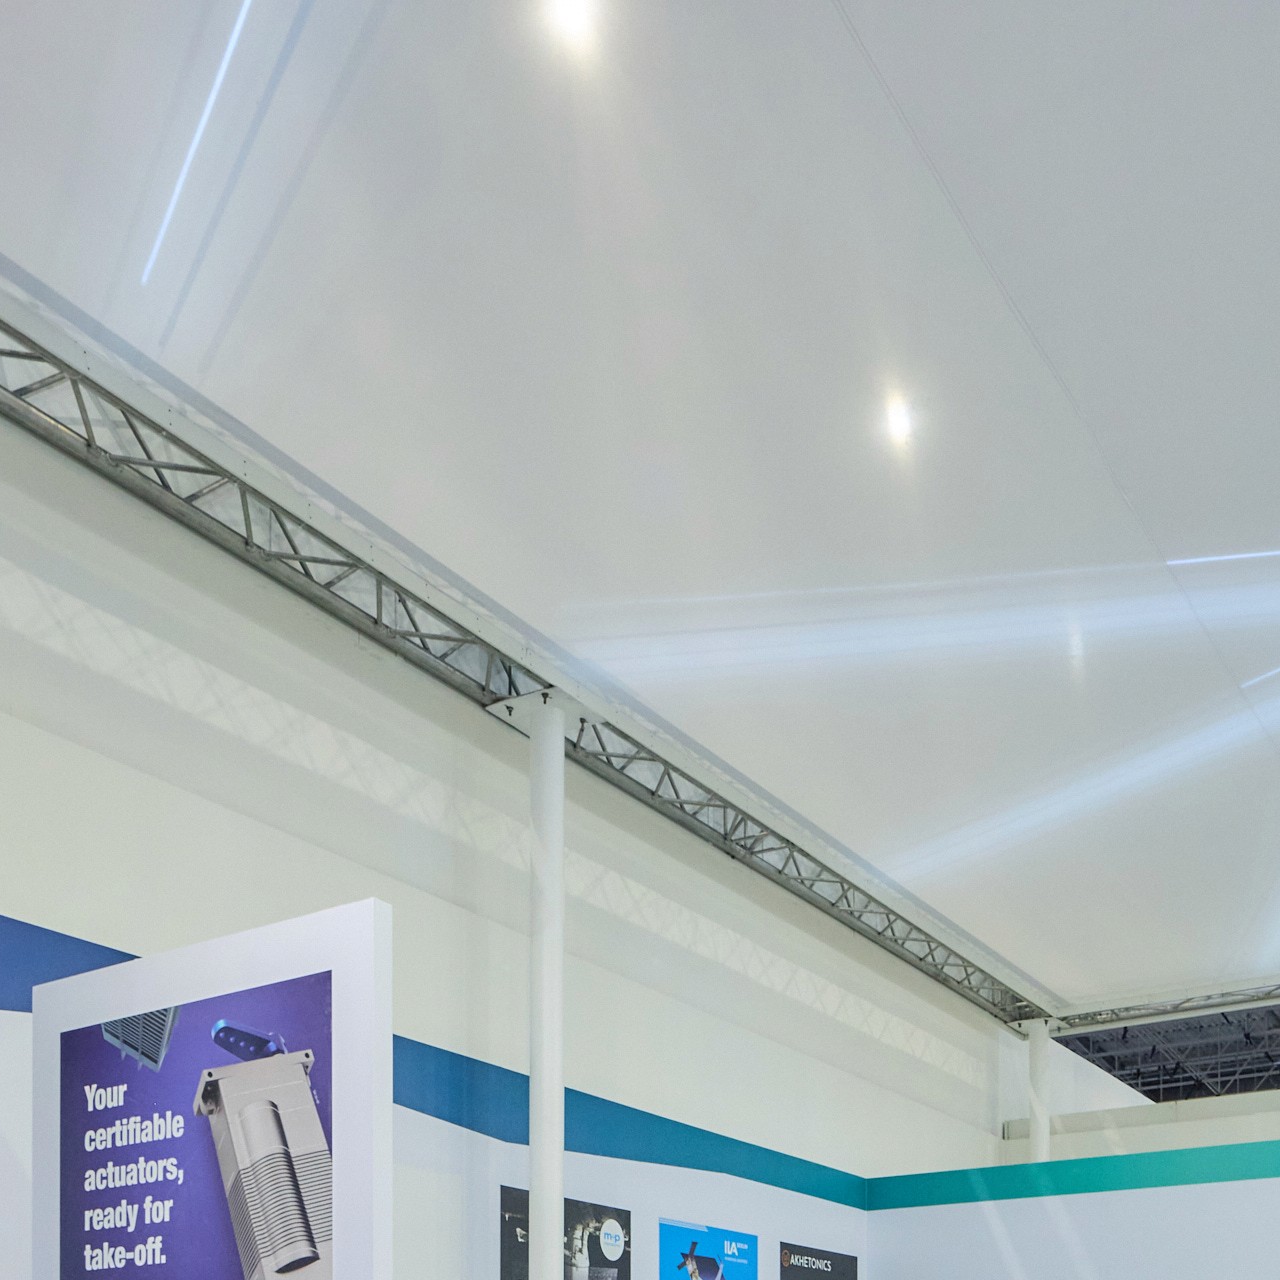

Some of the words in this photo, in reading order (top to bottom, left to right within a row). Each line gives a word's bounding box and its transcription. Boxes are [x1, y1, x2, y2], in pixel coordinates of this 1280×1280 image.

[83, 1084, 128, 1112] Your
[84, 1111, 185, 1152] certifiable
[84, 1157, 185, 1192] actuators,
[84, 1200, 139, 1232] ready
[144, 1196, 173, 1225] for
[84, 1236, 167, 1271] take-off.
[790, 1254, 832, 1272] AKHETONICS
